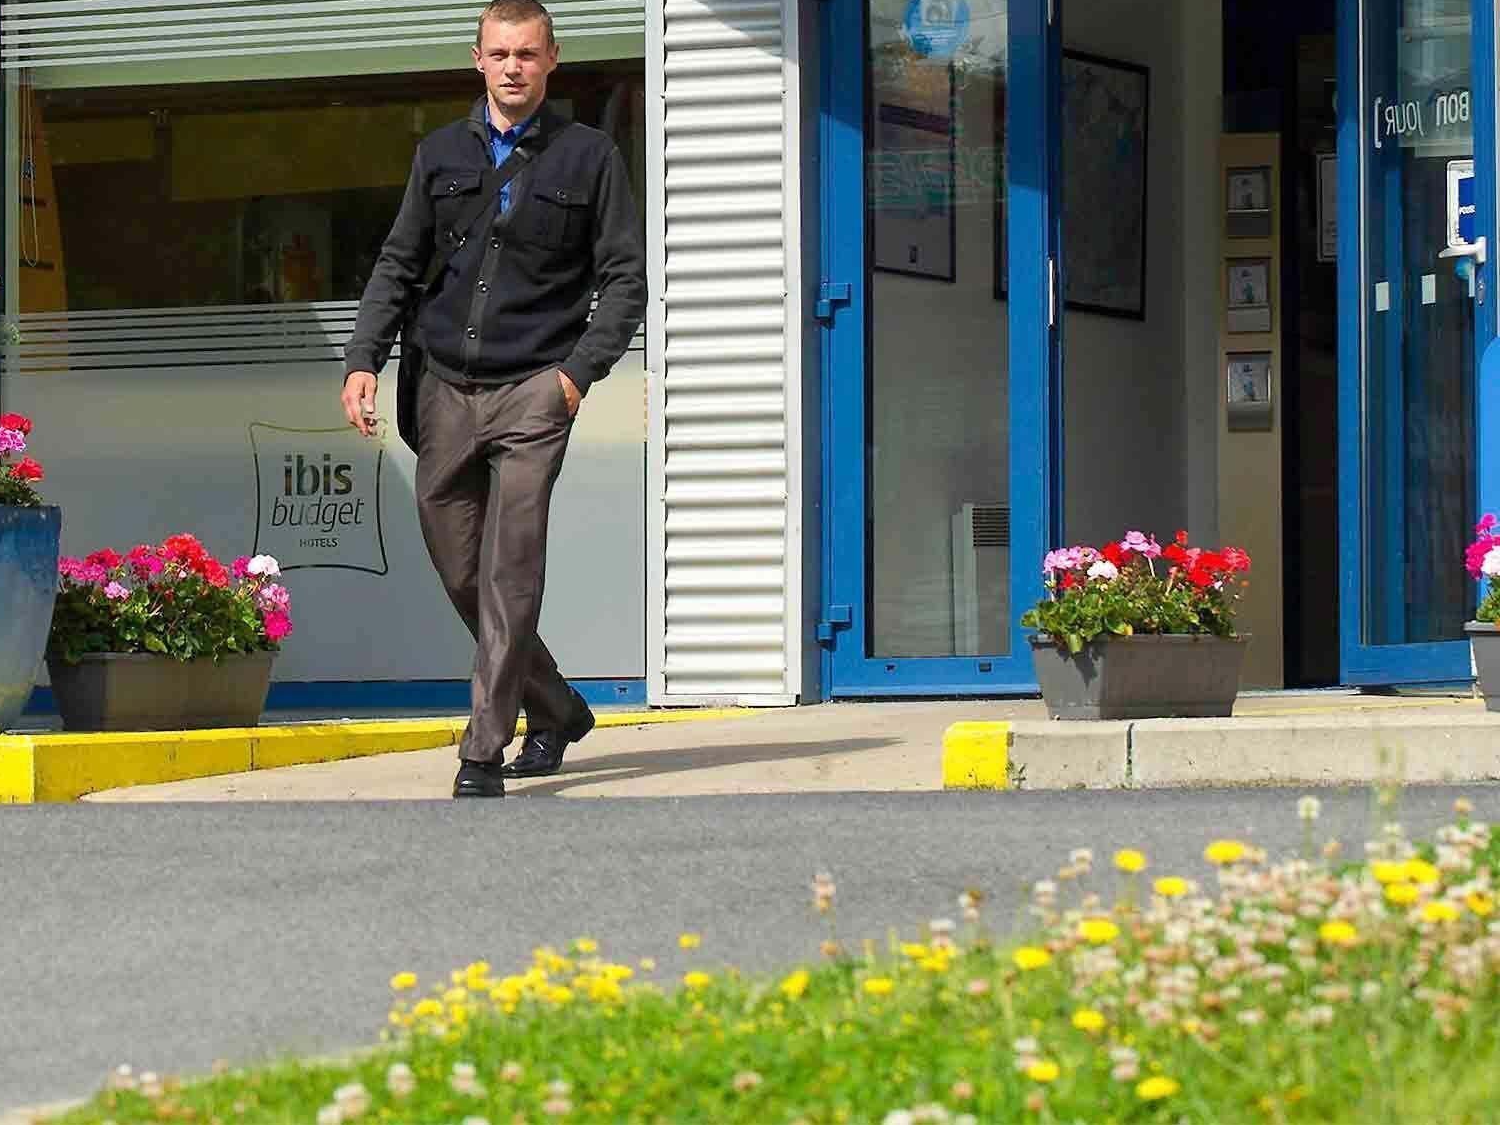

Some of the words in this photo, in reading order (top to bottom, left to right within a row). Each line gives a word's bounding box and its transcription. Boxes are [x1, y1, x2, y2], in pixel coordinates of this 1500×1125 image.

[284, 453, 353, 496] ibis
[271, 496, 365, 533] budget
[299, 537, 339, 548] HOTELS
